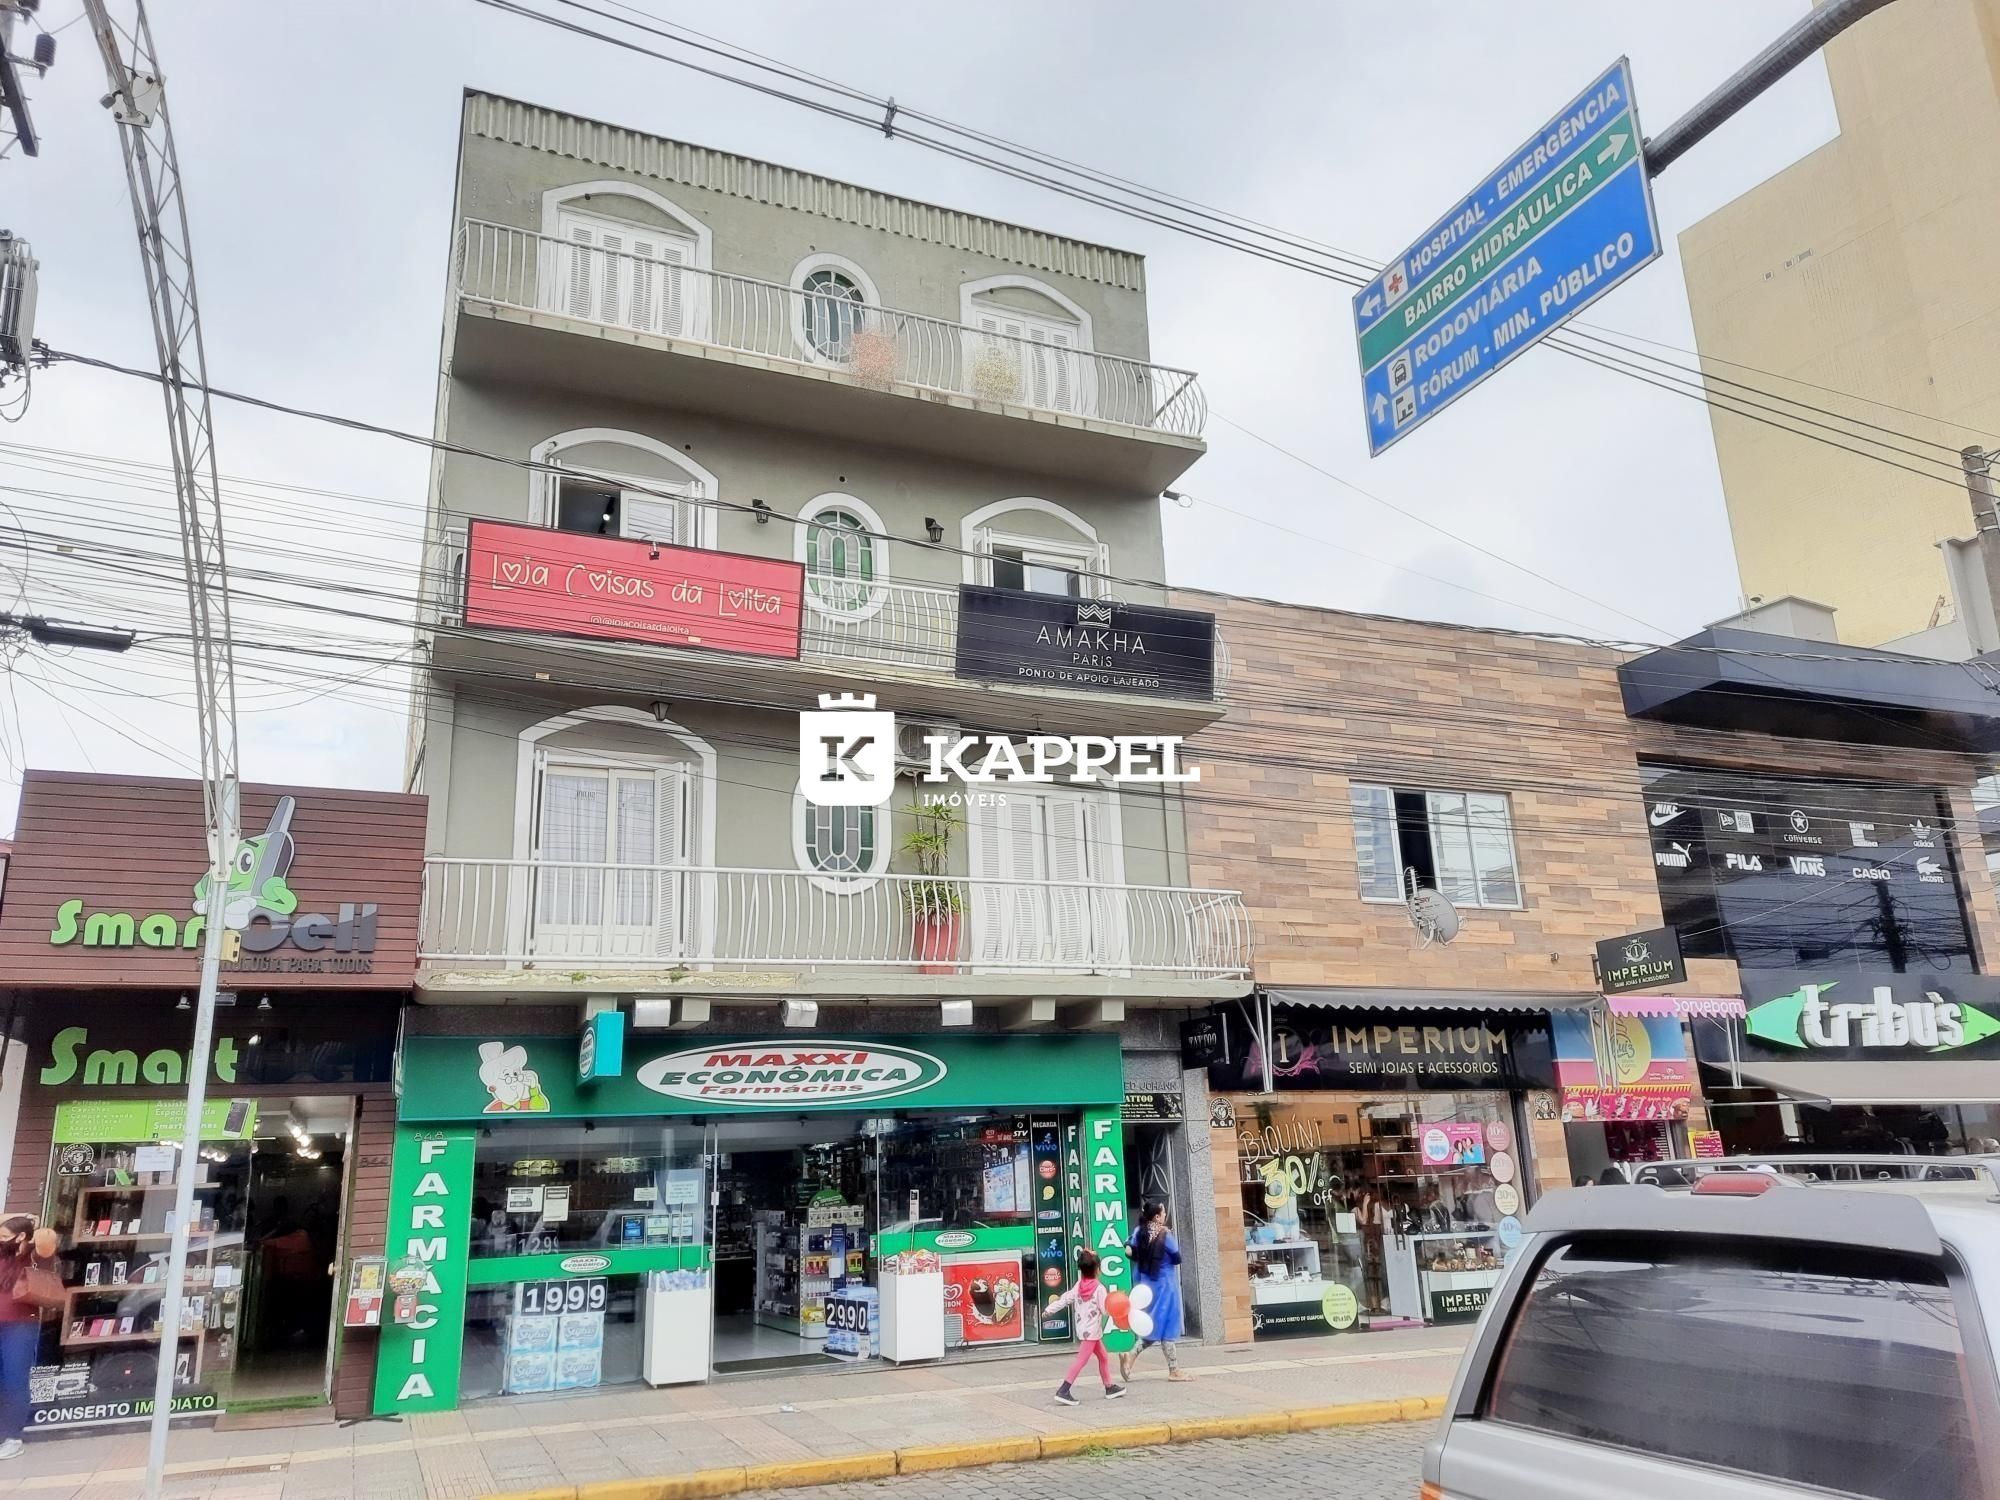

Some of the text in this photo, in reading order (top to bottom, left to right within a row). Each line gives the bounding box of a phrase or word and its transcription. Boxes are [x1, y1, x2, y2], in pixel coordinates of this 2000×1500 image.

[1410, 200, 1485, 276] HOSPITAL
[1498, 82, 1620, 200] EMERGÊNCIA
[1404, 161, 1593, 327] BAIRRO HIDRÁULICA
[1415, 255, 1543, 368] RODOVIÁRIA
[1419, 348, 1480, 405] FÓRUM
[1494, 315, 1536, 351] MIN.
[1540, 231, 1635, 315] PÚBLICO
[492, 553, 782, 617] Loja Coisas da Lolita
[1036, 624, 1147, 656] AMAKHA
[1073, 651, 1113, 668] PARIS
[1018, 666, 1160, 688] PONTO DE APOIO LAJEADO
[1655, 802, 1678, 815] NIKE
[1913, 840, 1935, 848] adidas
[1655, 852, 1687, 867] PUMA
[1725, 853, 1763, 870] FILA
[1789, 856, 1826, 877] VANS
[1852, 867, 1891, 880] CASIO
[1919, 875, 1945, 884] LACOSTE
[50, 899, 377, 953] Smar Cell
[1607, 959, 1674, 982] IMPERIUM
[1673, 998, 1743, 1013] Sorvebom
[1332, 1025, 1508, 1055] IMPERIUM
[703, 1052, 870, 1067] MAXXI
[1349, 1059, 1498, 1074] SEMI JOIAS E ACESSÓRIOS
[659, 1066, 908, 1086] ECONÔMICA
[700, 1083, 864, 1096] Farmácias
[1124, 1095, 1154, 1103] ATTOO
[1035, 1143, 1058, 1151] vivo
[1259, 1151, 1325, 1209] 30%
[1093, 1120, 1129, 1333] FARMÁCA
[1040, 1249, 1063, 1258] vivo
[396, 1140, 449, 1402] FARMÁCIA
[35, 1395, 215, 1423] CONSERTO IMDIATO
